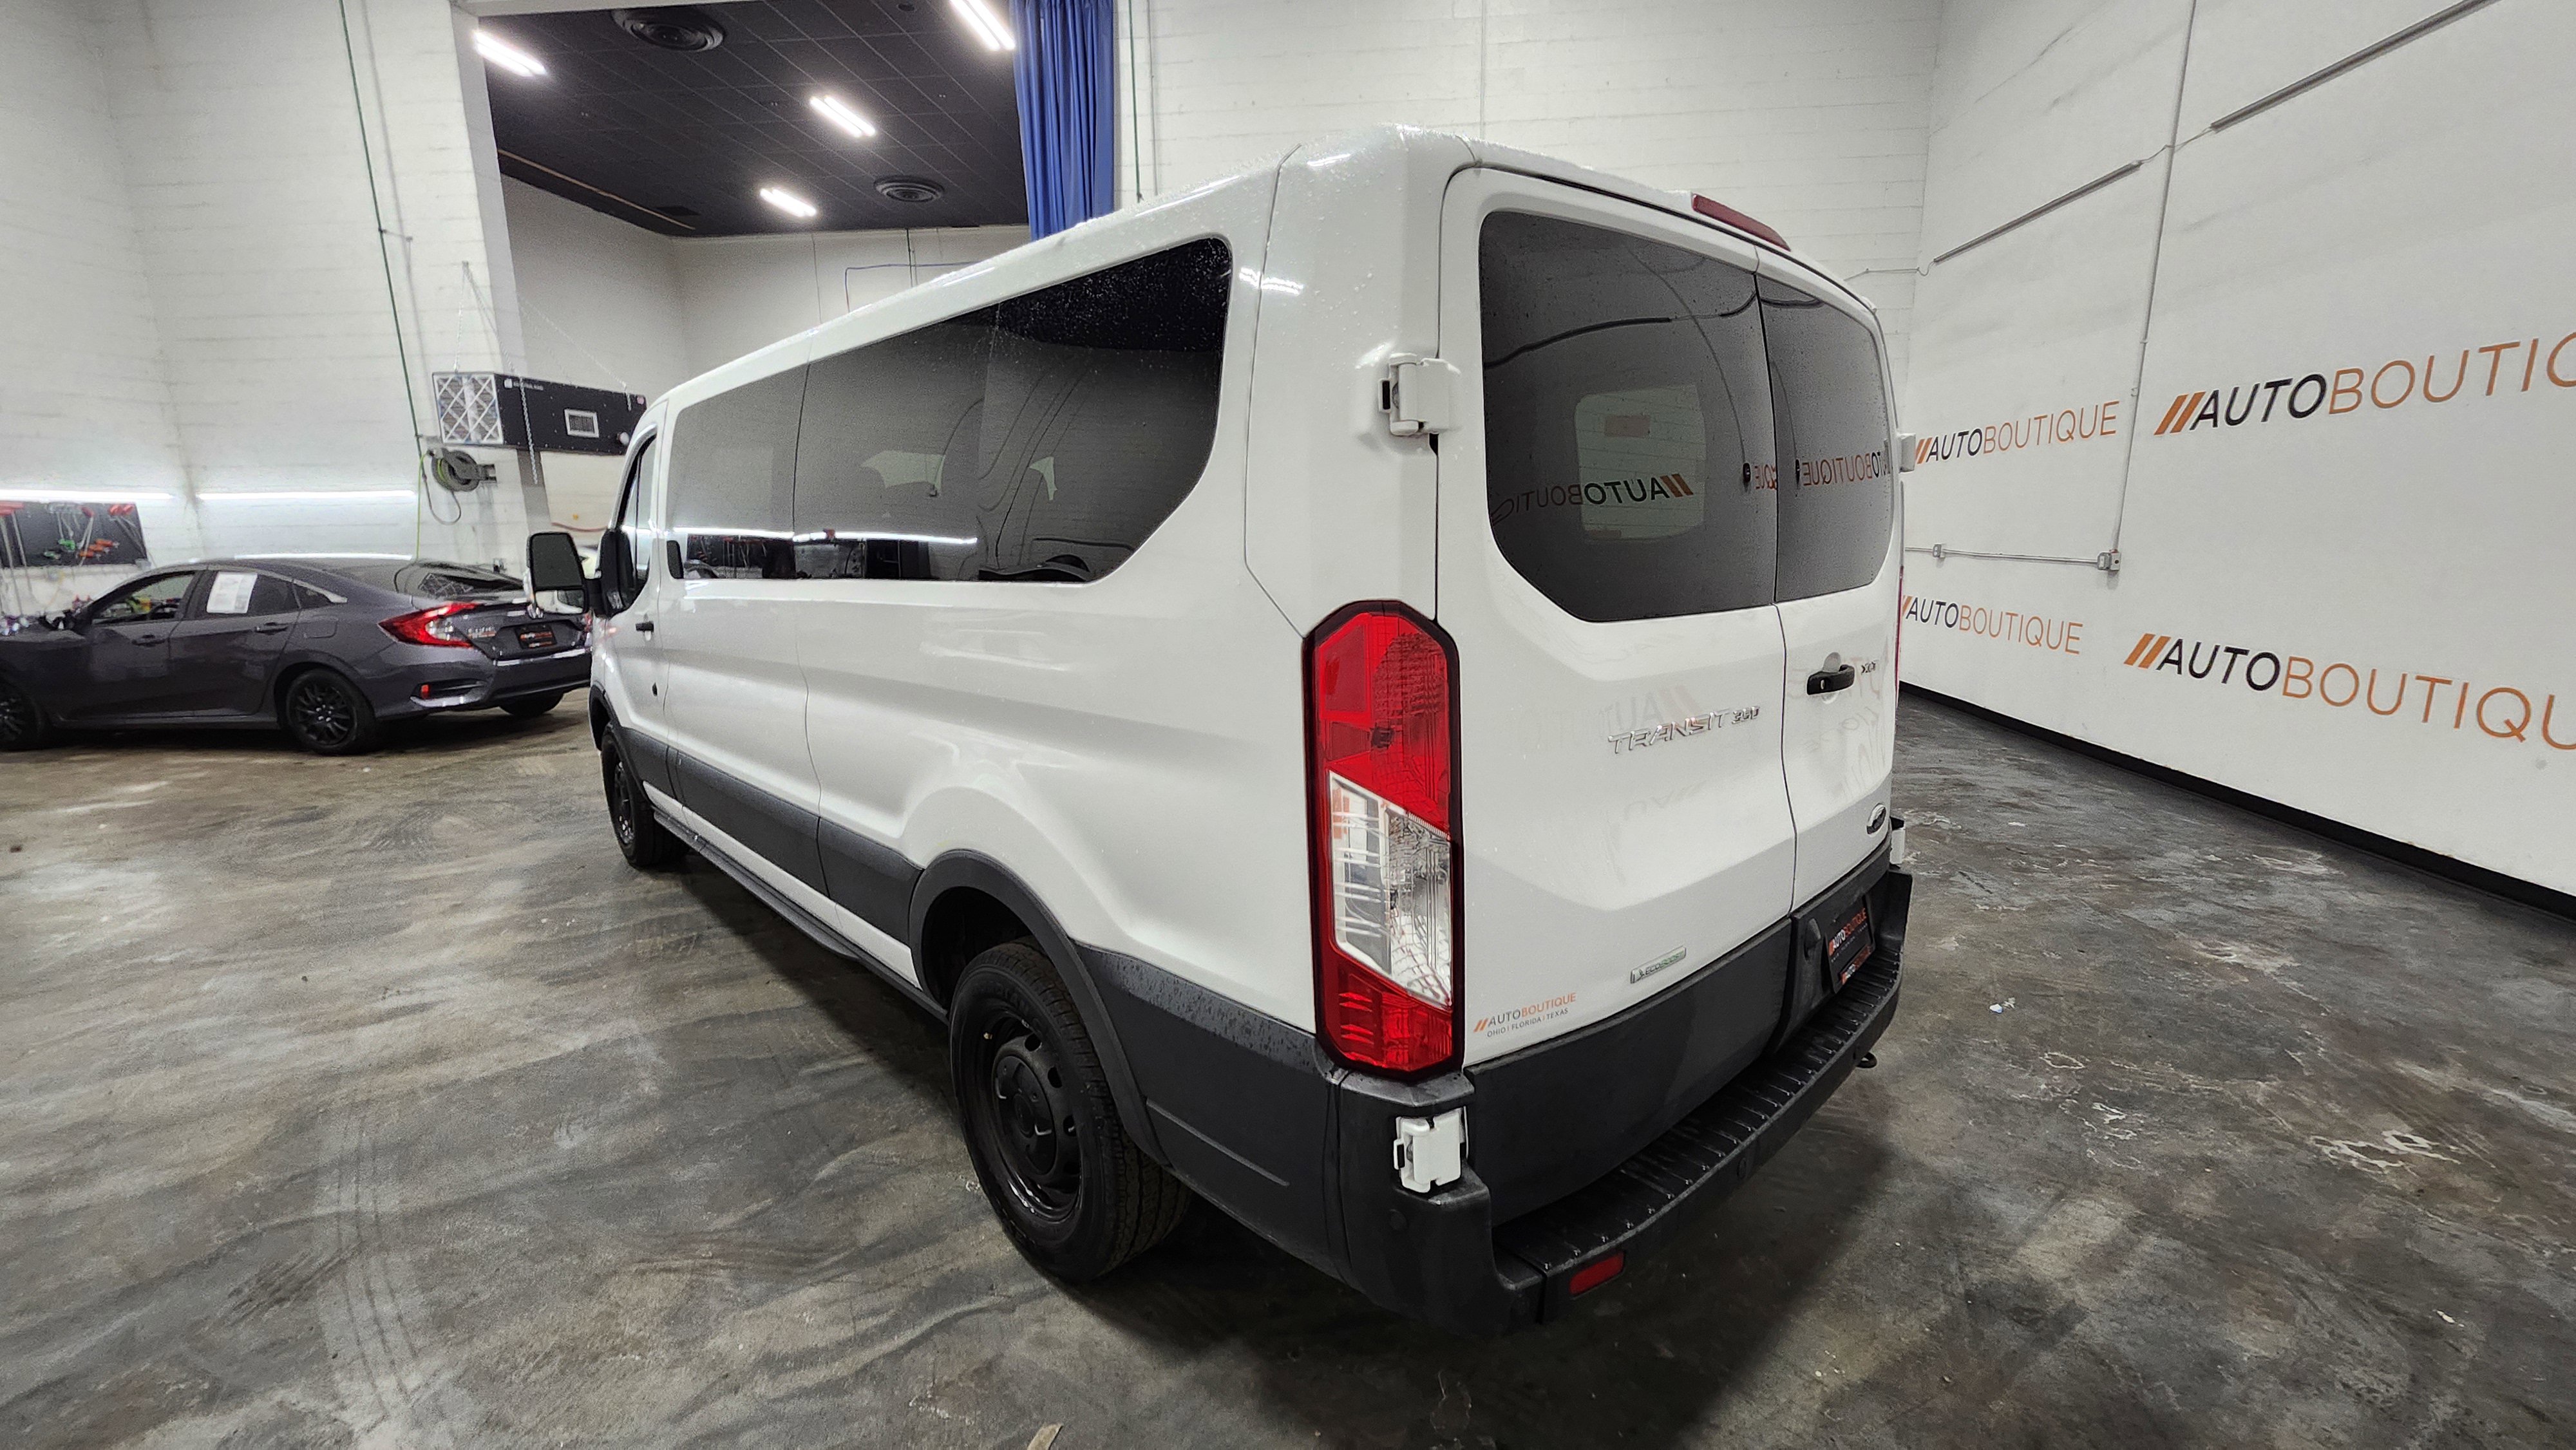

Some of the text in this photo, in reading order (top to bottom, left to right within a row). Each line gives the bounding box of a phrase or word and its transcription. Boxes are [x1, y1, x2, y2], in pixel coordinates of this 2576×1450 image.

[1926, 400, 2119, 463] AUTOBOUTIQUE
[1906, 597, 2083, 654] AUTOBOUTIQUE
[1608, 708, 1730, 754] TRANSIT
[1487, 1008, 1569, 1037] OHIO FLORIDA TEXAS
[1488, 992, 1577, 1028] AUTOBOUTIQUE
